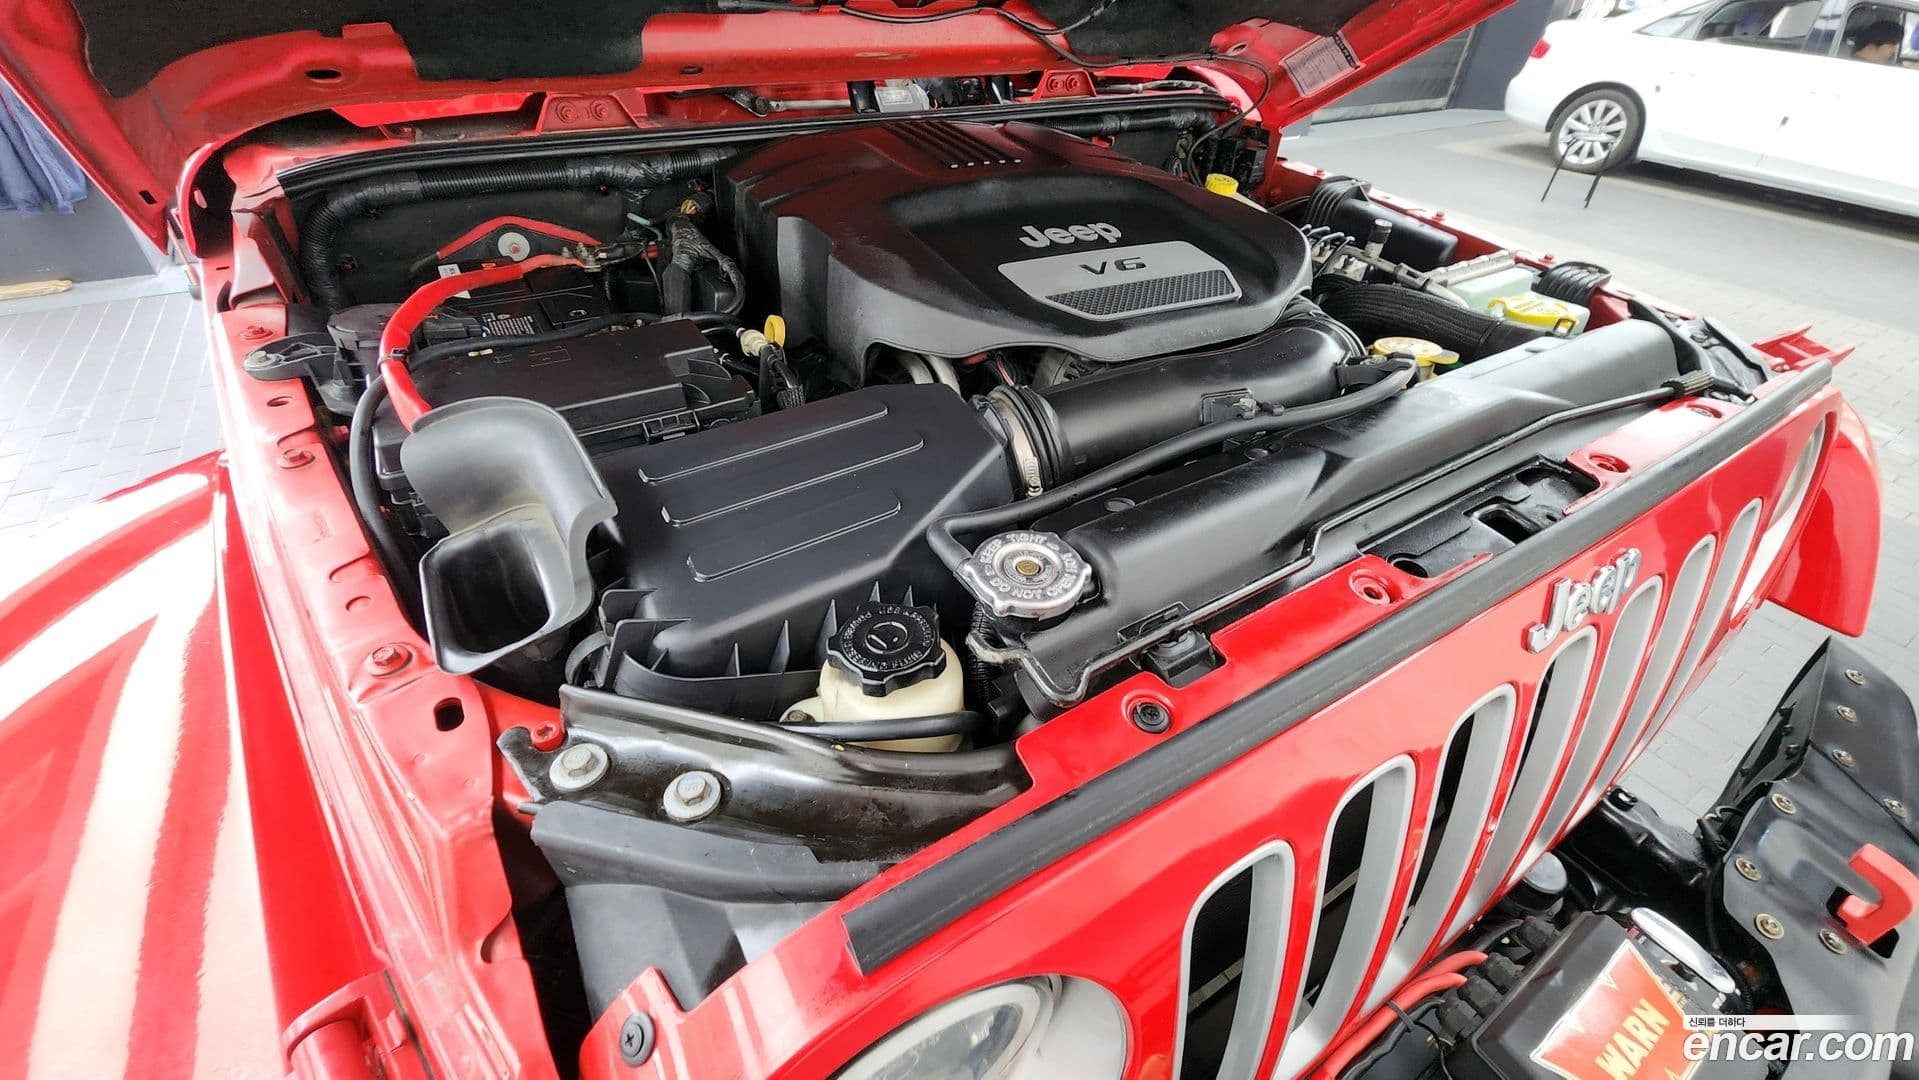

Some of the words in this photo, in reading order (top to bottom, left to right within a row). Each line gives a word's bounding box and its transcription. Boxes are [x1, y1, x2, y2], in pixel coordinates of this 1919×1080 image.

[1018, 221, 1122, 248] Jeep
[1079, 256, 1147, 275] V6
[980, 538, 1002, 564] KEEP
[1006, 533, 1048, 543] TIGHT
[990, 578, 1011, 593] DO
[1012, 588, 1043, 599] NOT
[1046, 573, 1077, 597] OPEN
[1524, 547, 1640, 654] Jeep
[1594, 997, 1671, 1080] WARN
